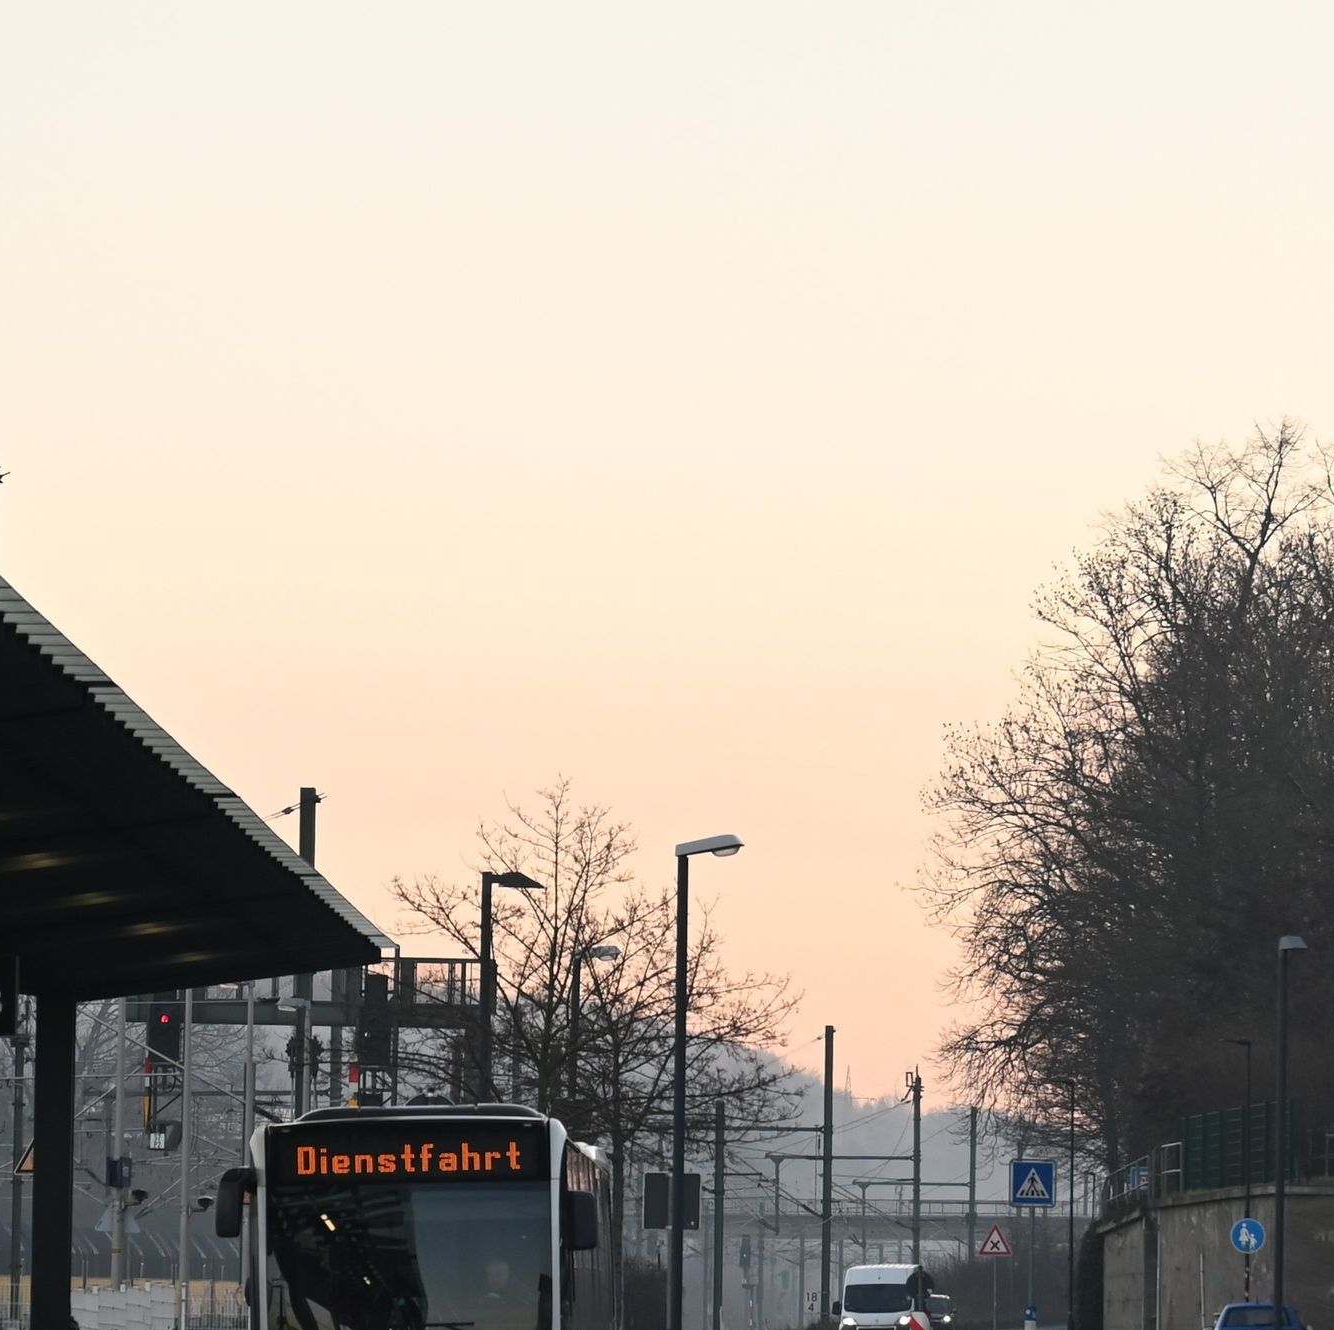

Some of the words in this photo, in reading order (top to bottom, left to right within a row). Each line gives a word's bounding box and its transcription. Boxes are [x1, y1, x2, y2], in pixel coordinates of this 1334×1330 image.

[297, 1141, 521, 1175] Dienstfahrt
[806, 1292, 818, 1302] 18
[808, 1303, 815, 1312] 4
